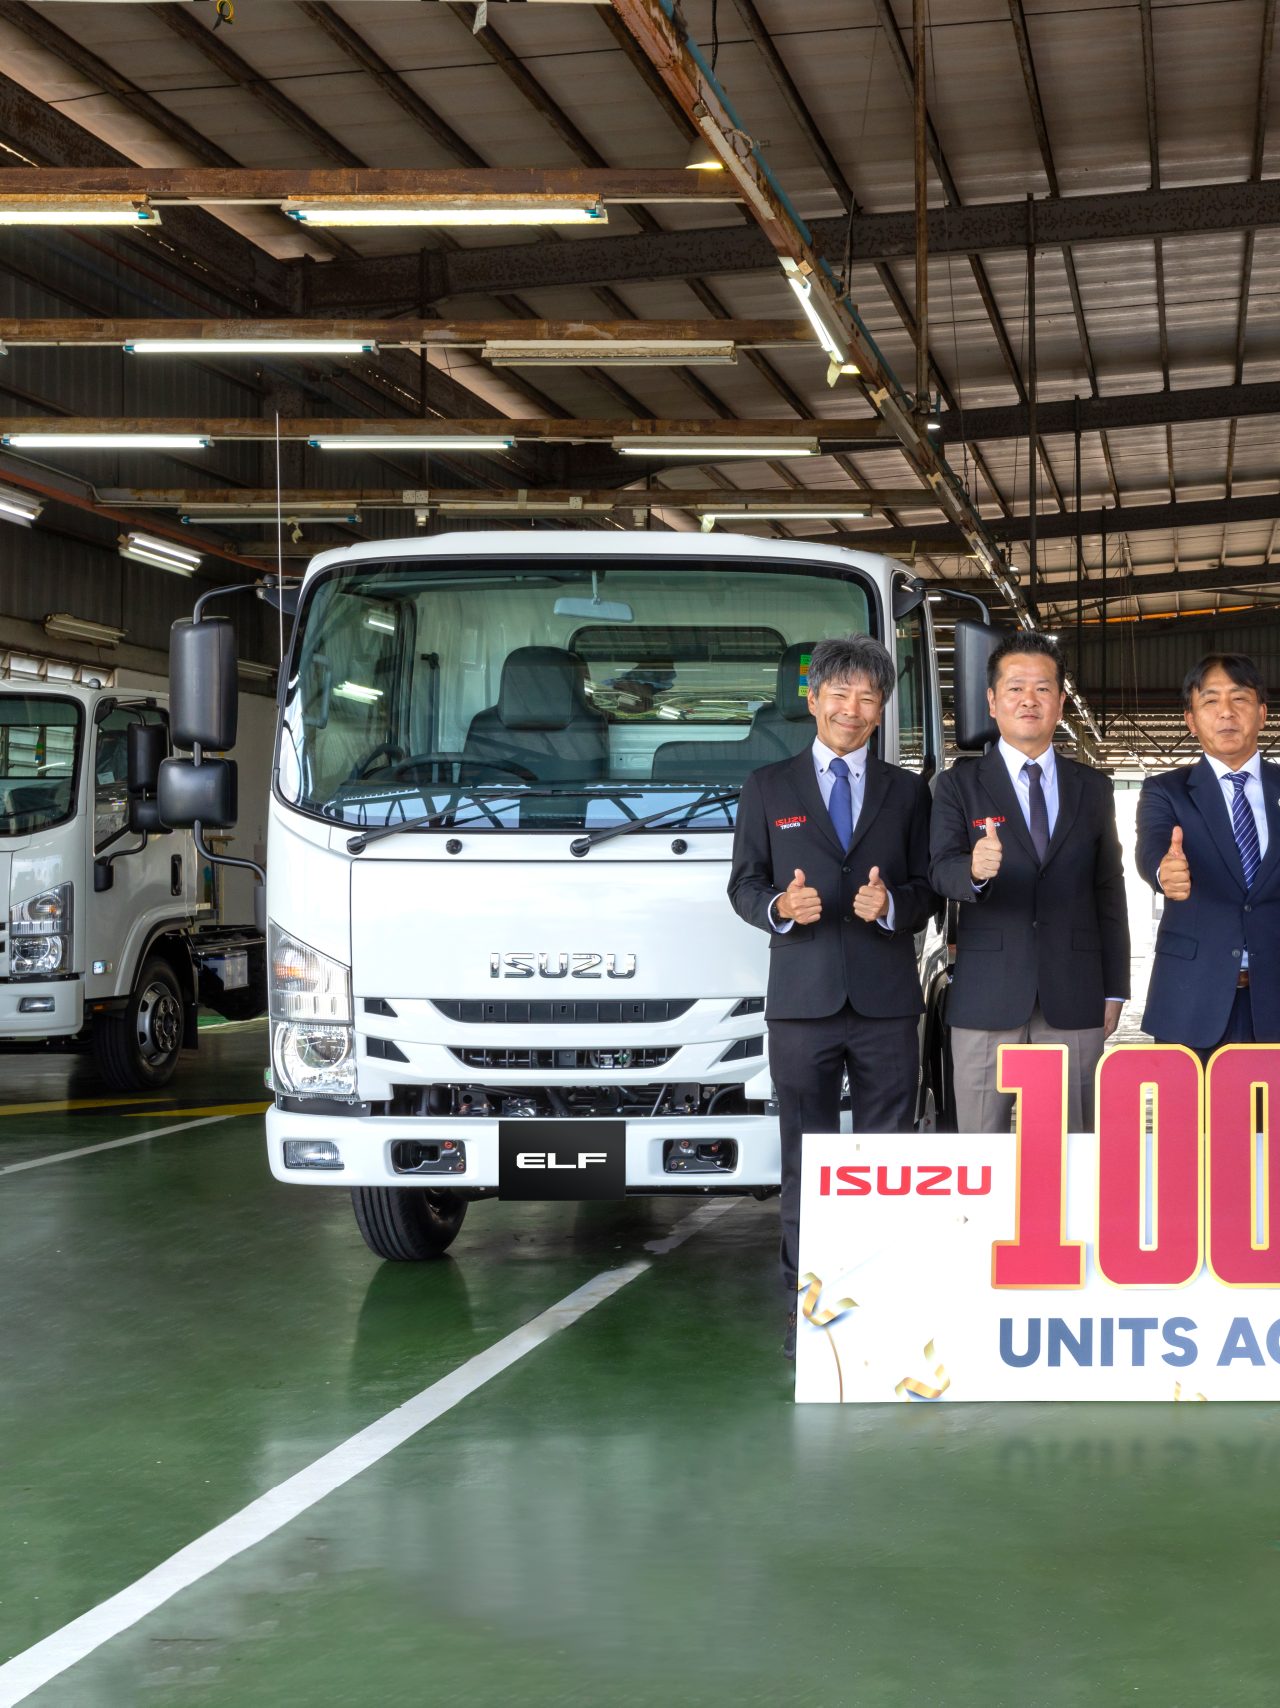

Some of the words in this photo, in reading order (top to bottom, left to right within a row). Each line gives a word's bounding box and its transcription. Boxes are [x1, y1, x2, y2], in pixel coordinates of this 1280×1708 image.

[775, 815, 807, 827] ISUZU
[490, 952, 637, 979] ISUZU
[516, 1152, 608, 1169] ELF
[820, 1165, 992, 1196] ISUZU
[999, 1316, 1199, 1368] UNITS
